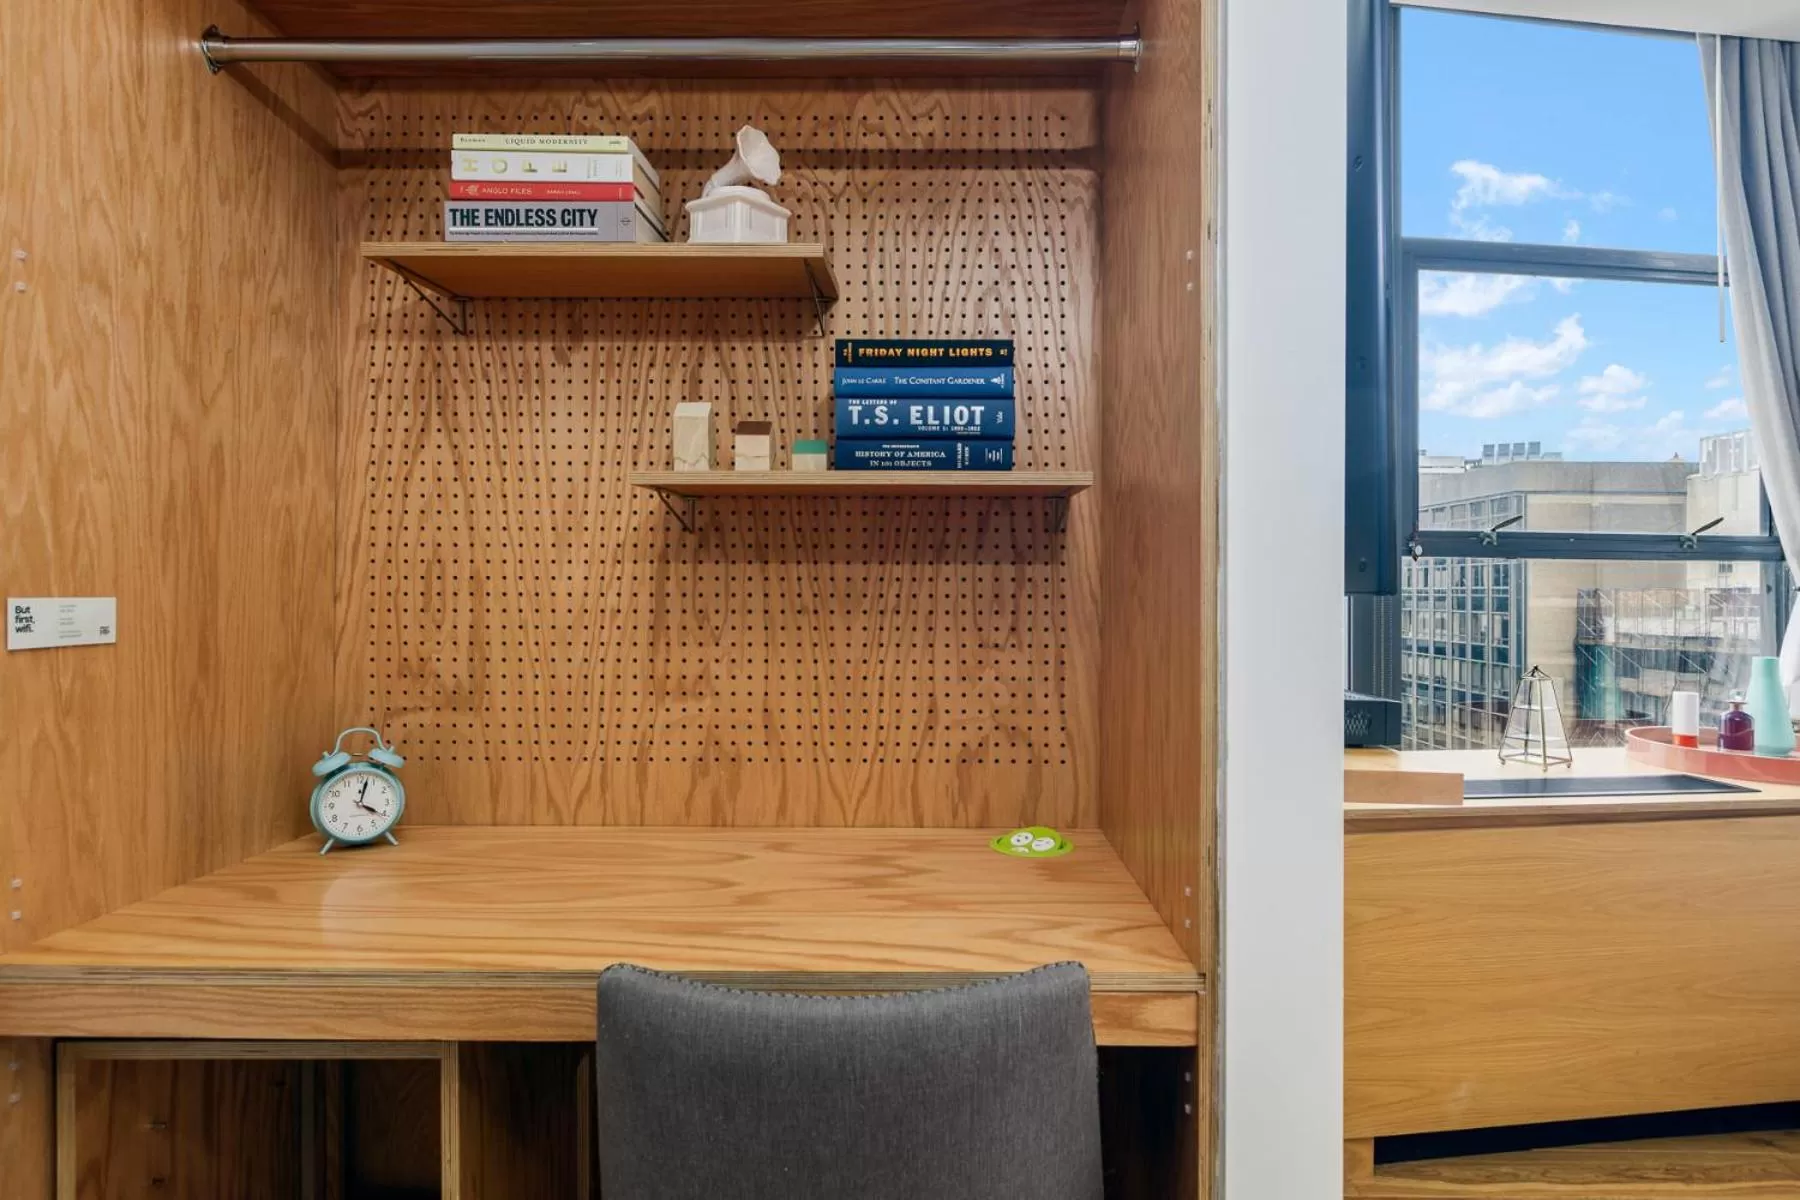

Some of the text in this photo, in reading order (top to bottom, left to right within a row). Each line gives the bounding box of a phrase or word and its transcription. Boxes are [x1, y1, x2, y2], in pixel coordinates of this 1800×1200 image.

[505, 137, 588, 146] LIQUID MODERNITY
[482, 187, 532, 195] ANGLO FILES
[449, 208, 598, 227] THE ENDLESS CITY
[858, 347, 903, 357] FRIDAY
[906, 347, 945, 357] NIGHT
[948, 347, 993, 357] LIGHTS
[909, 377, 946, 385] CONSTANT
[947, 376, 985, 385] GARDENER
[910, 405, 985, 426] ELIOT
[855, 450, 947, 458] HISTORY OF AMERICA
[15, 605, 31, 614] But
[15, 615, 36, 624] first,
[15, 624, 34, 633] wifi.
[328, 802, 335, 810] 9
[332, 814, 338, 822] 8
[343, 822, 348, 830] 7
[370, 819, 376, 827] 5
